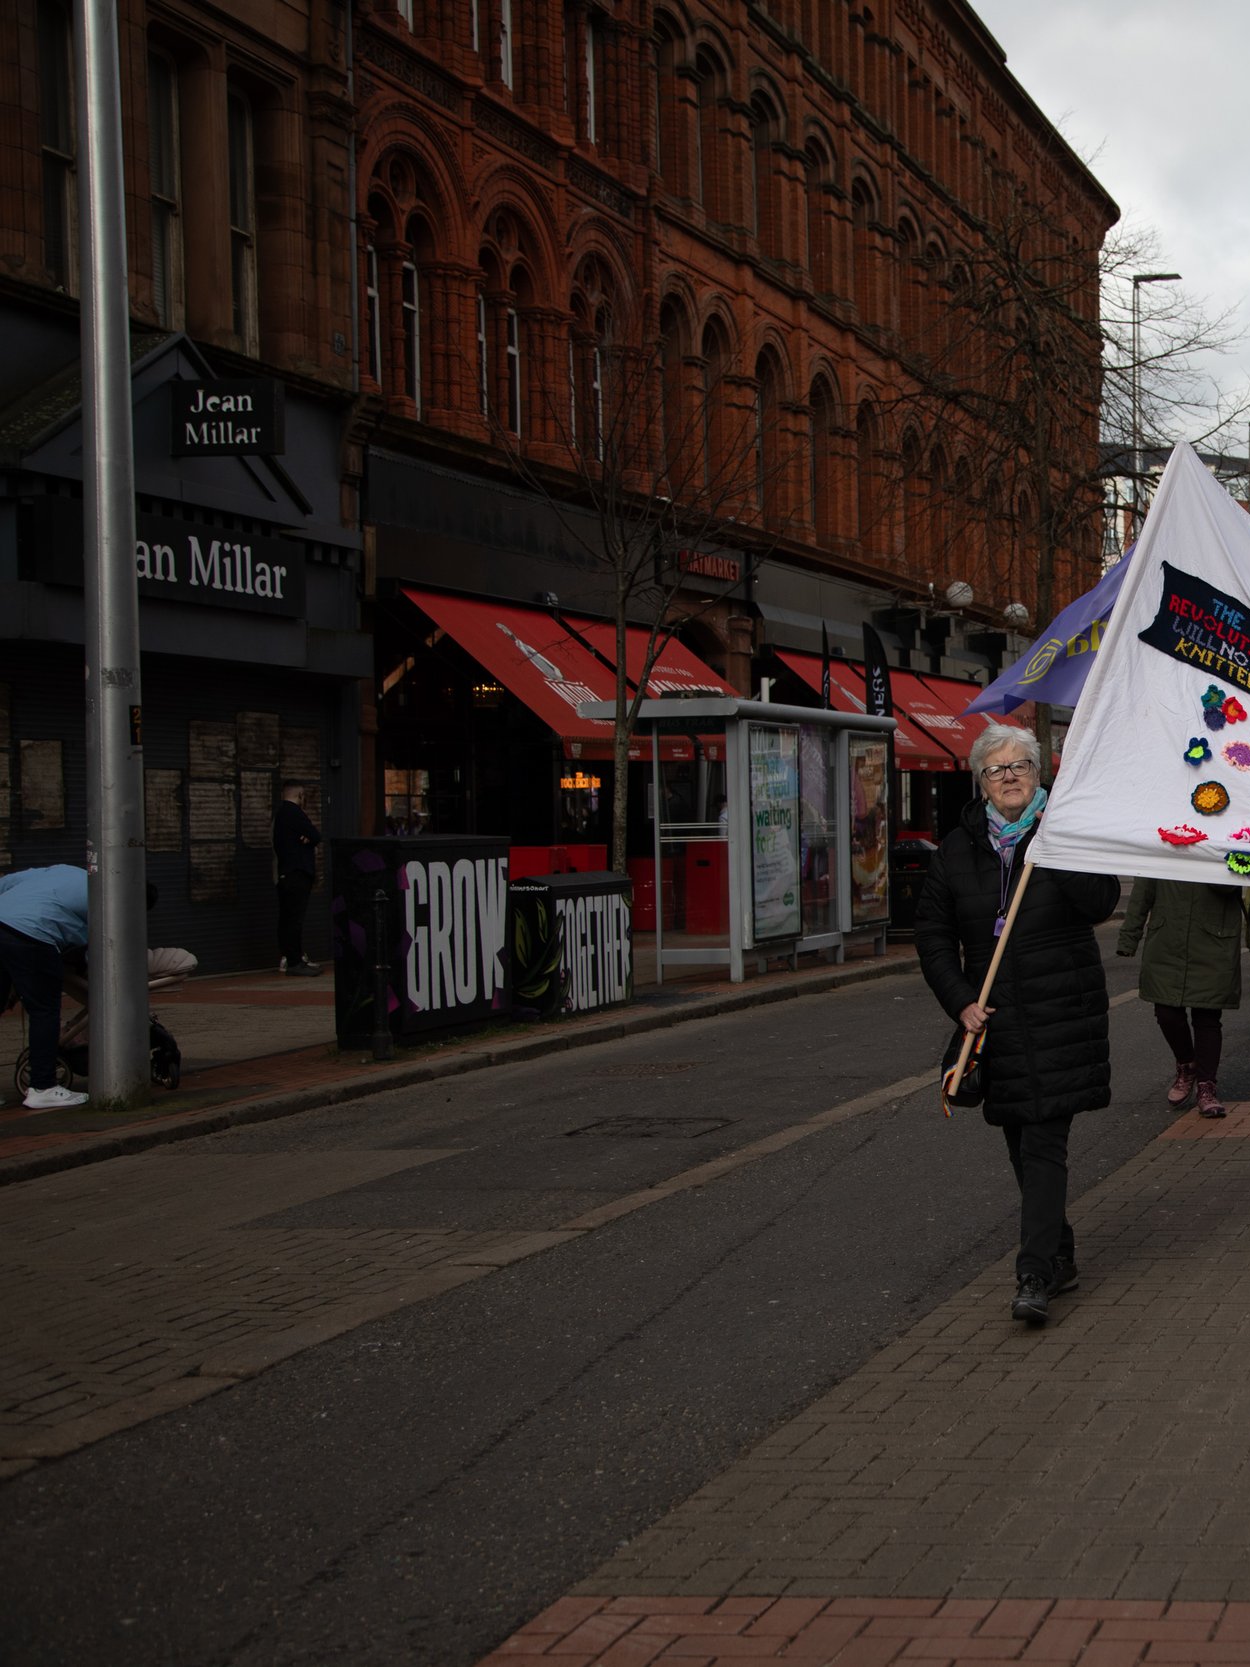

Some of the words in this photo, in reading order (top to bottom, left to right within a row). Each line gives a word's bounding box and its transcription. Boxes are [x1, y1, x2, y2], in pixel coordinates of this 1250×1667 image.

[190, 389, 254, 413] Jean
[184, 421, 261, 445] Millar
[136, 539, 178, 583] an
[187, 535, 287, 599] Millar
[1212, 598, 1246, 631] THE
[1172, 615, 1218, 652] WILL
[755, 802, 792, 830] waiting
[405, 857, 508, 1012] GROW
[556, 893, 631, 1013] TOGETHER
